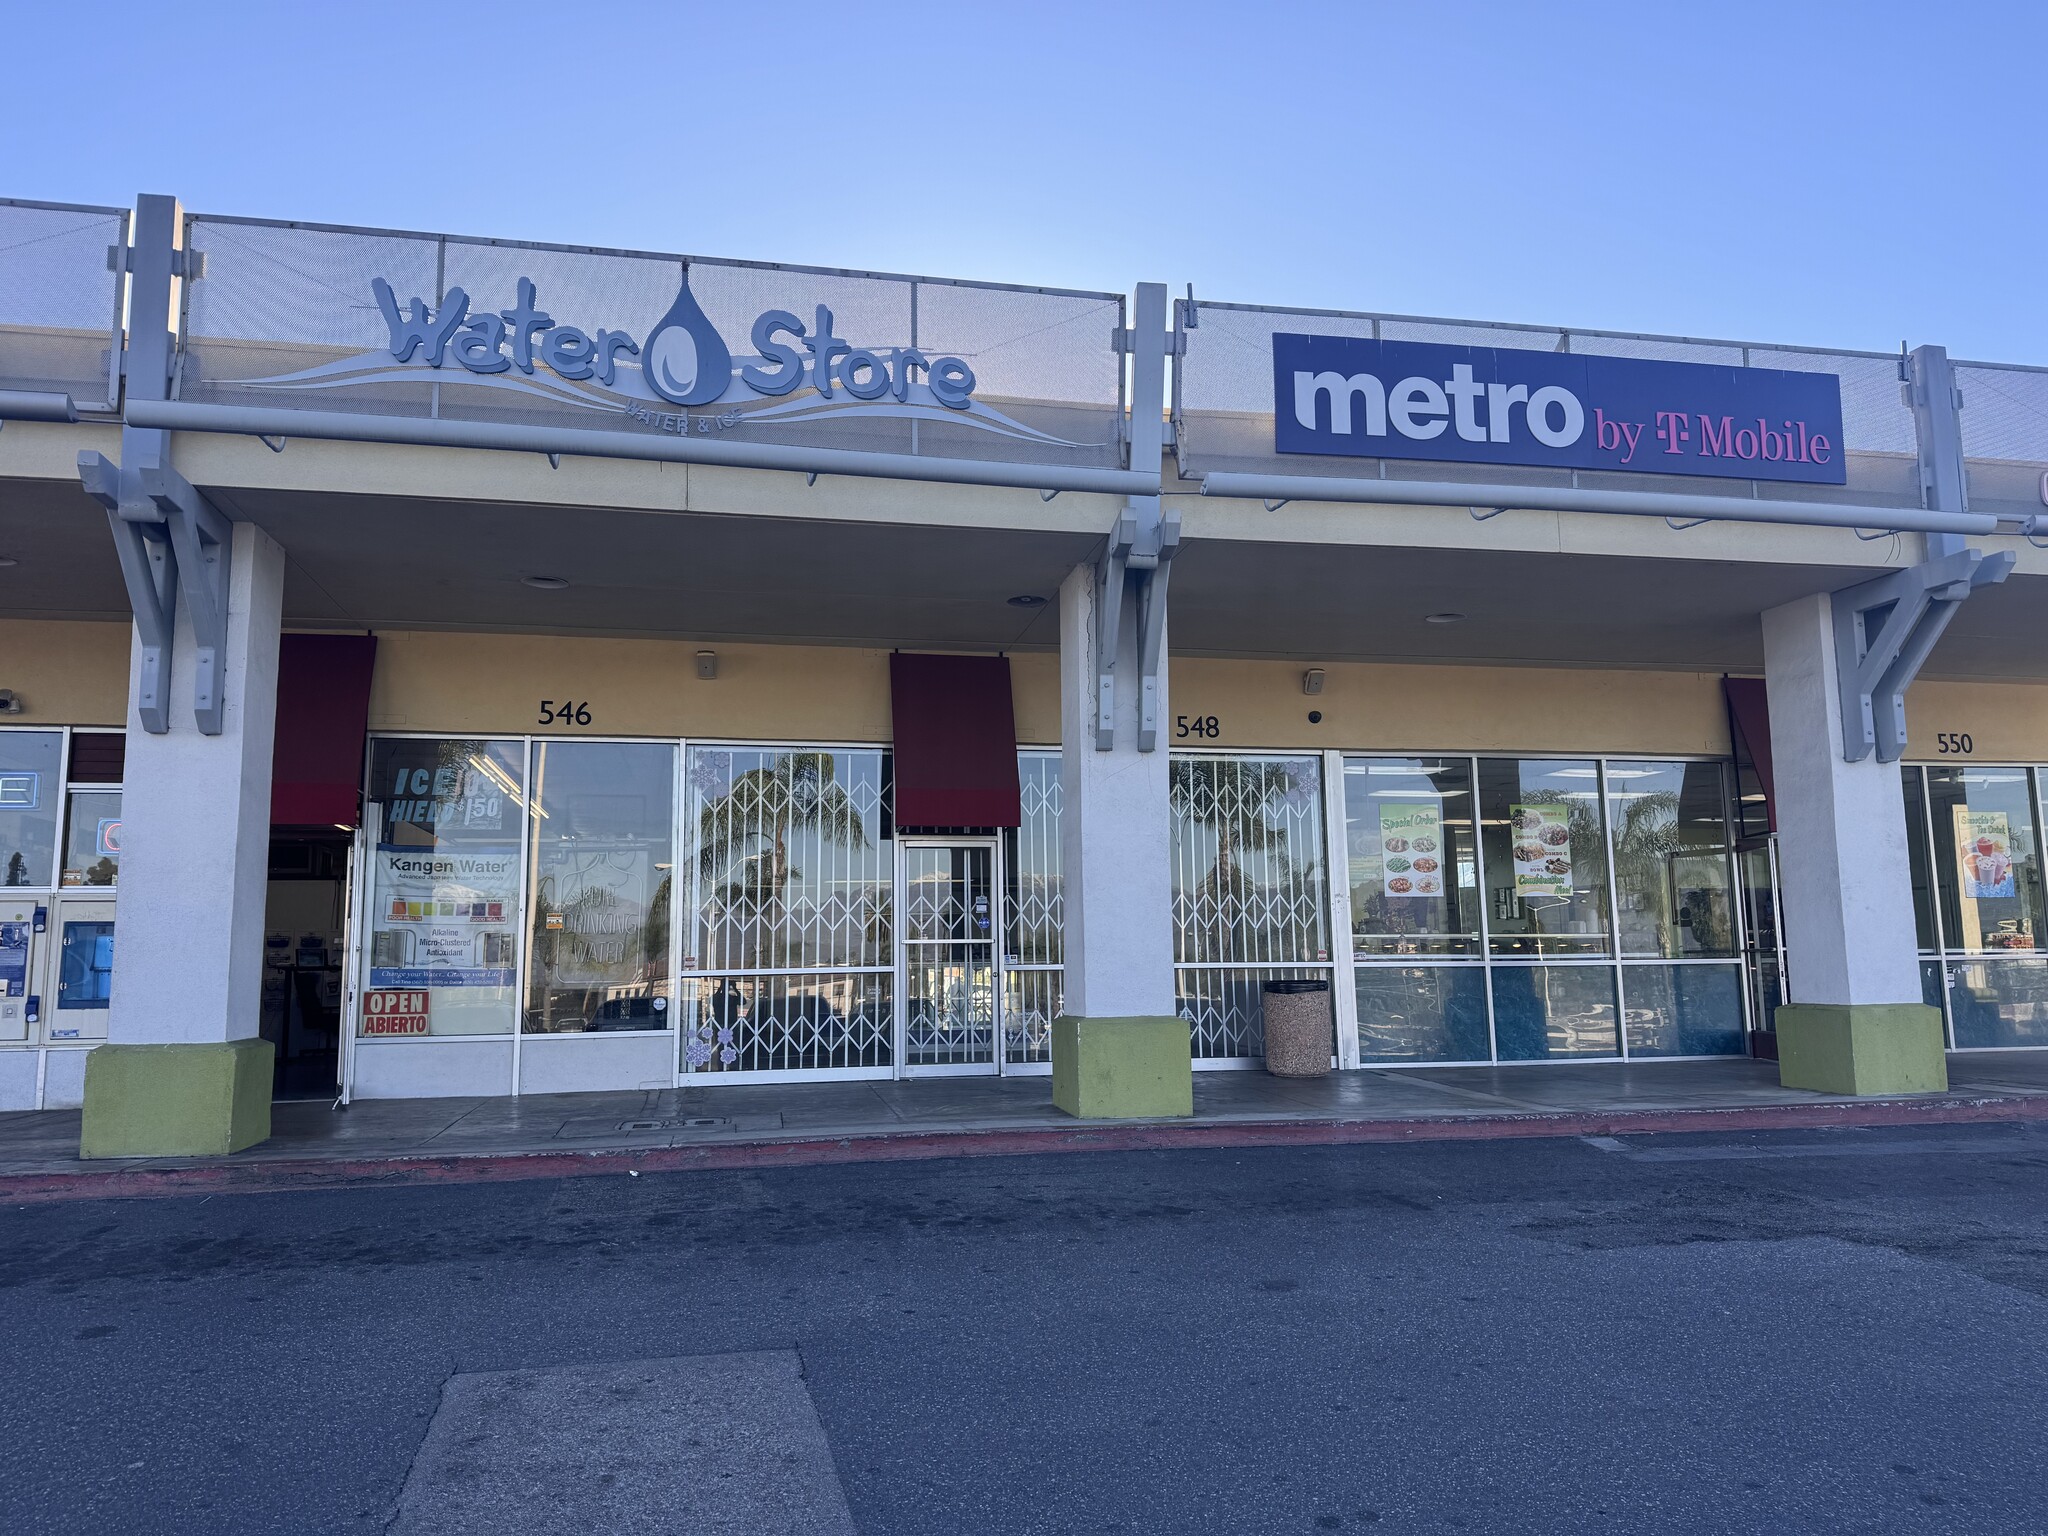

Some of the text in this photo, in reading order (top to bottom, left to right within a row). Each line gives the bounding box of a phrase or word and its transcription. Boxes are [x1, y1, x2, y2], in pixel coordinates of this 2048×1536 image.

[371, 276, 977, 410] Water Store
[623, 399, 689, 434] WATER
[715, 407, 744, 430] ICE
[1293, 363, 1585, 448] metro
[1593, 408, 1646, 464] by
[538, 700, 592, 726] 546
[1176, 715, 1220, 739] 548
[1937, 733, 1973, 754] 550
[394, 768, 454, 796] ICE
[1382, 813, 1437, 833] Special Order
[390, 857, 508, 875] Kangen Water
[397, 873, 426, 881] Advanced
[1519, 873, 1565, 885] Combination
[431, 928, 459, 937] Alkaline
[563, 912, 638, 935] DRINKING
[419, 938, 471, 947] Micro-Clustered
[426, 948, 463, 957] Antioxidant
[573, 941, 625, 964] WATER
[381, 970, 405, 979] Change
[370, 993, 423, 1014] OPEN
[364, 1015, 427, 1034] ABIERTO
